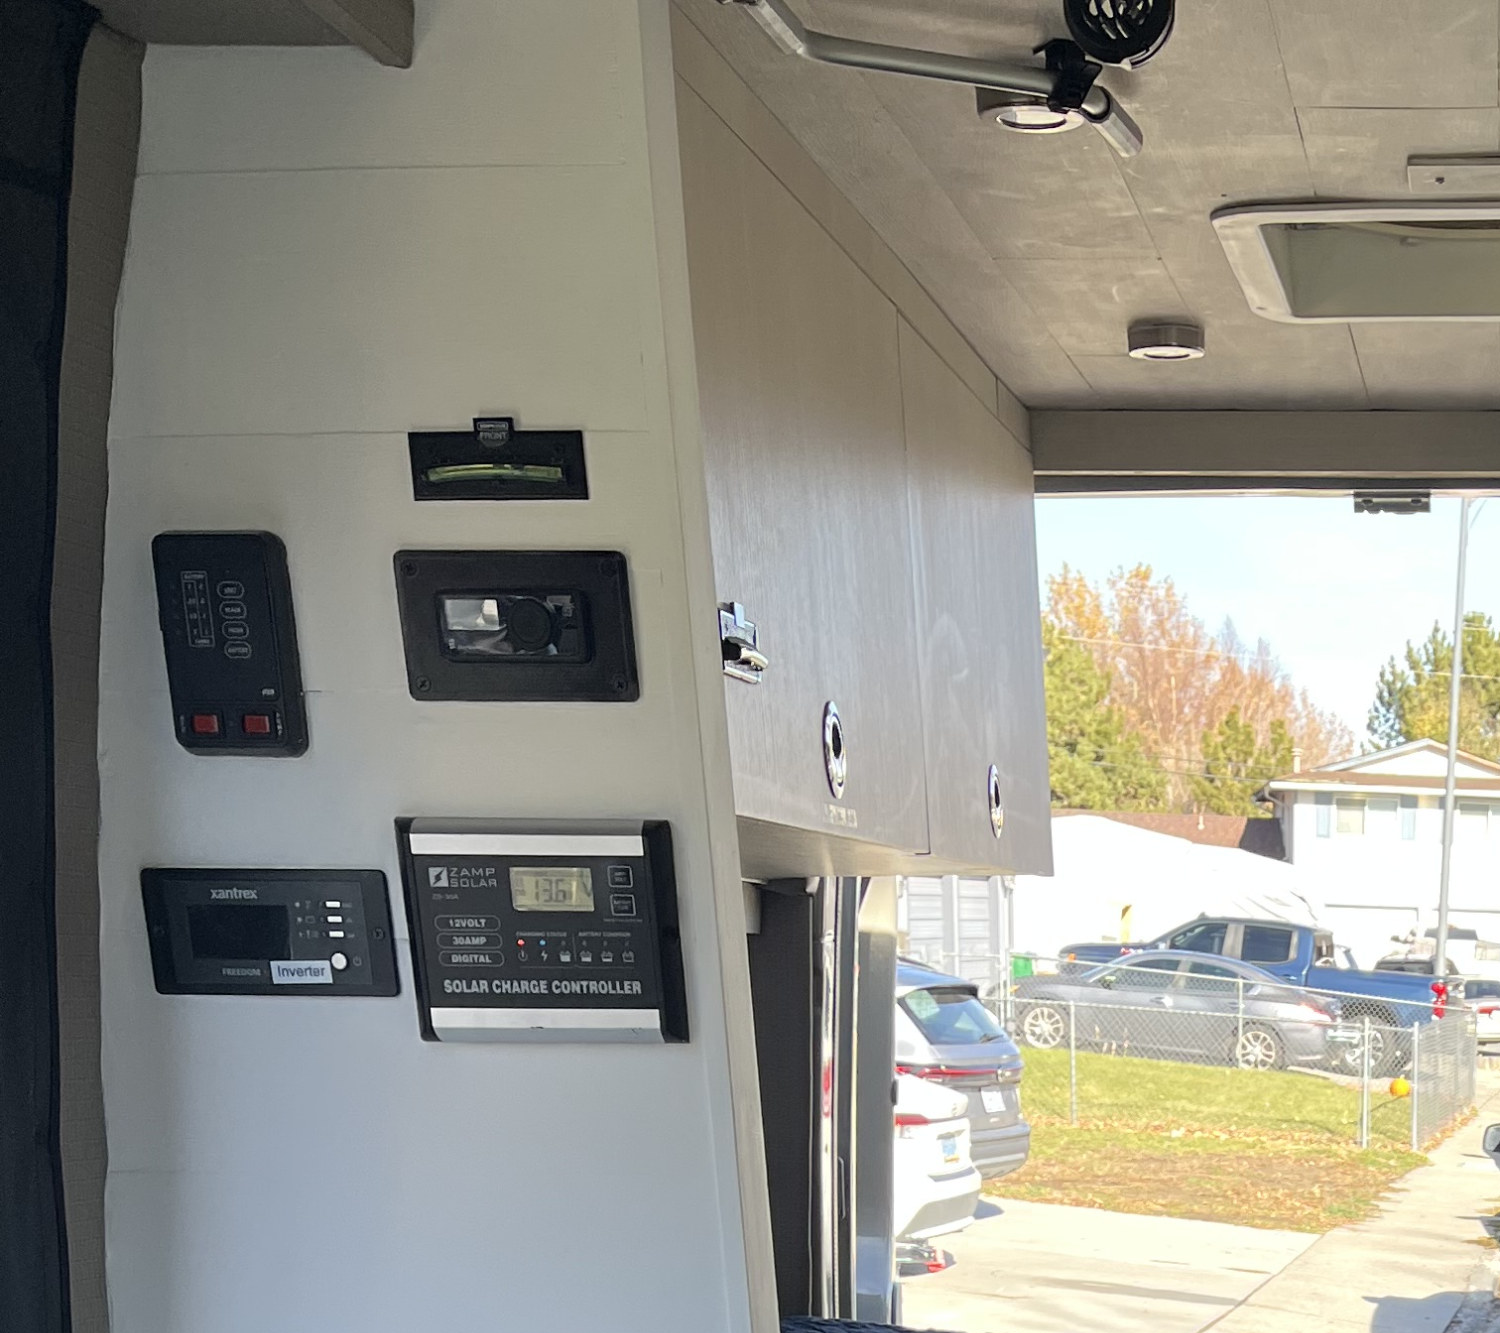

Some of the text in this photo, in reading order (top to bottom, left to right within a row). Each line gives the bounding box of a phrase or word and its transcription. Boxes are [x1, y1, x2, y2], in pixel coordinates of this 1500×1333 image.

[450, 867, 495, 877] ZAMP
[450, 878, 497, 888] SOLAR
[210, 887, 258, 900] xantrex
[448, 918, 487, 929] 12VOLT
[452, 936, 488, 946] 30AMP
[451, 954, 492, 964] DIGITAL
[277, 965, 326, 978] Inverter
[444, 980, 642, 995] SOLAR CHARGE CONTROLLER
